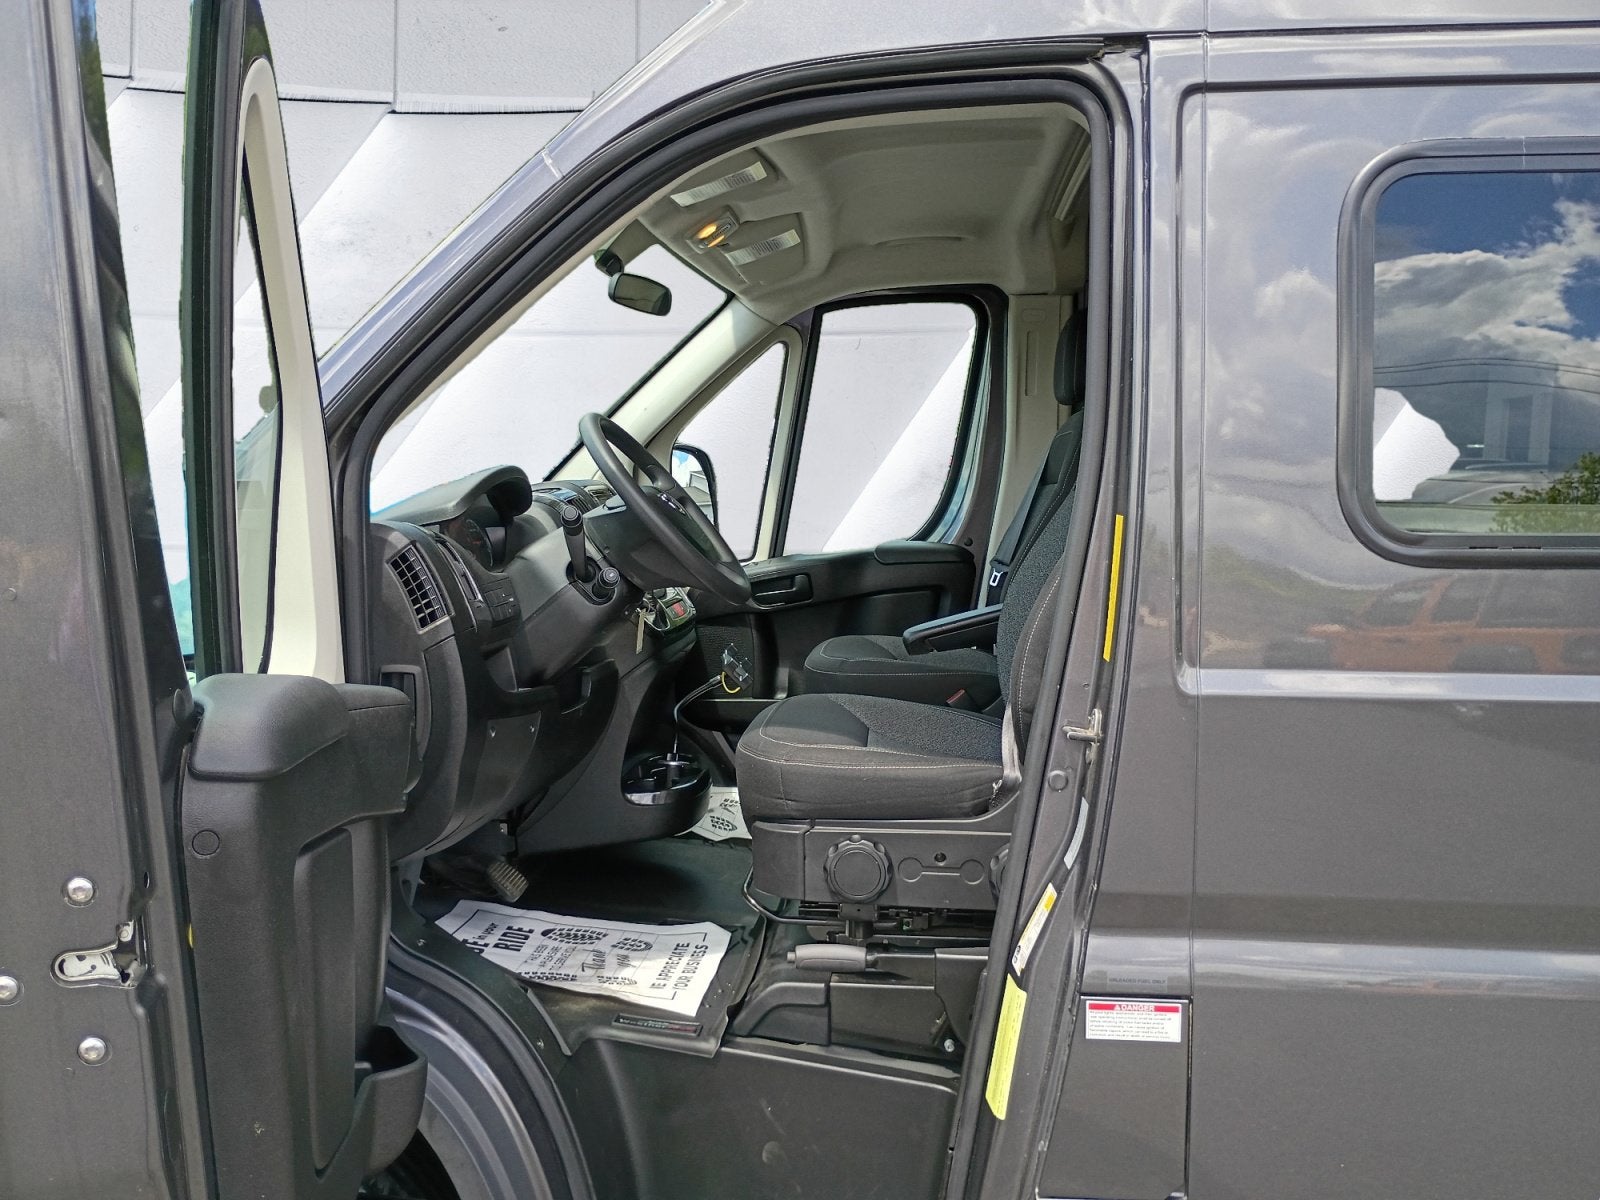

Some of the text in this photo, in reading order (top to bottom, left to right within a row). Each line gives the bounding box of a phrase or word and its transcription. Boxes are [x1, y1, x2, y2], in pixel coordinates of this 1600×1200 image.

[492, 925, 535, 952] RIDE
[655, 942, 690, 982] APPRECIATE
[681, 944, 709, 974] BUSINESS
[1121, 1004, 1155, 1012] DANGER
